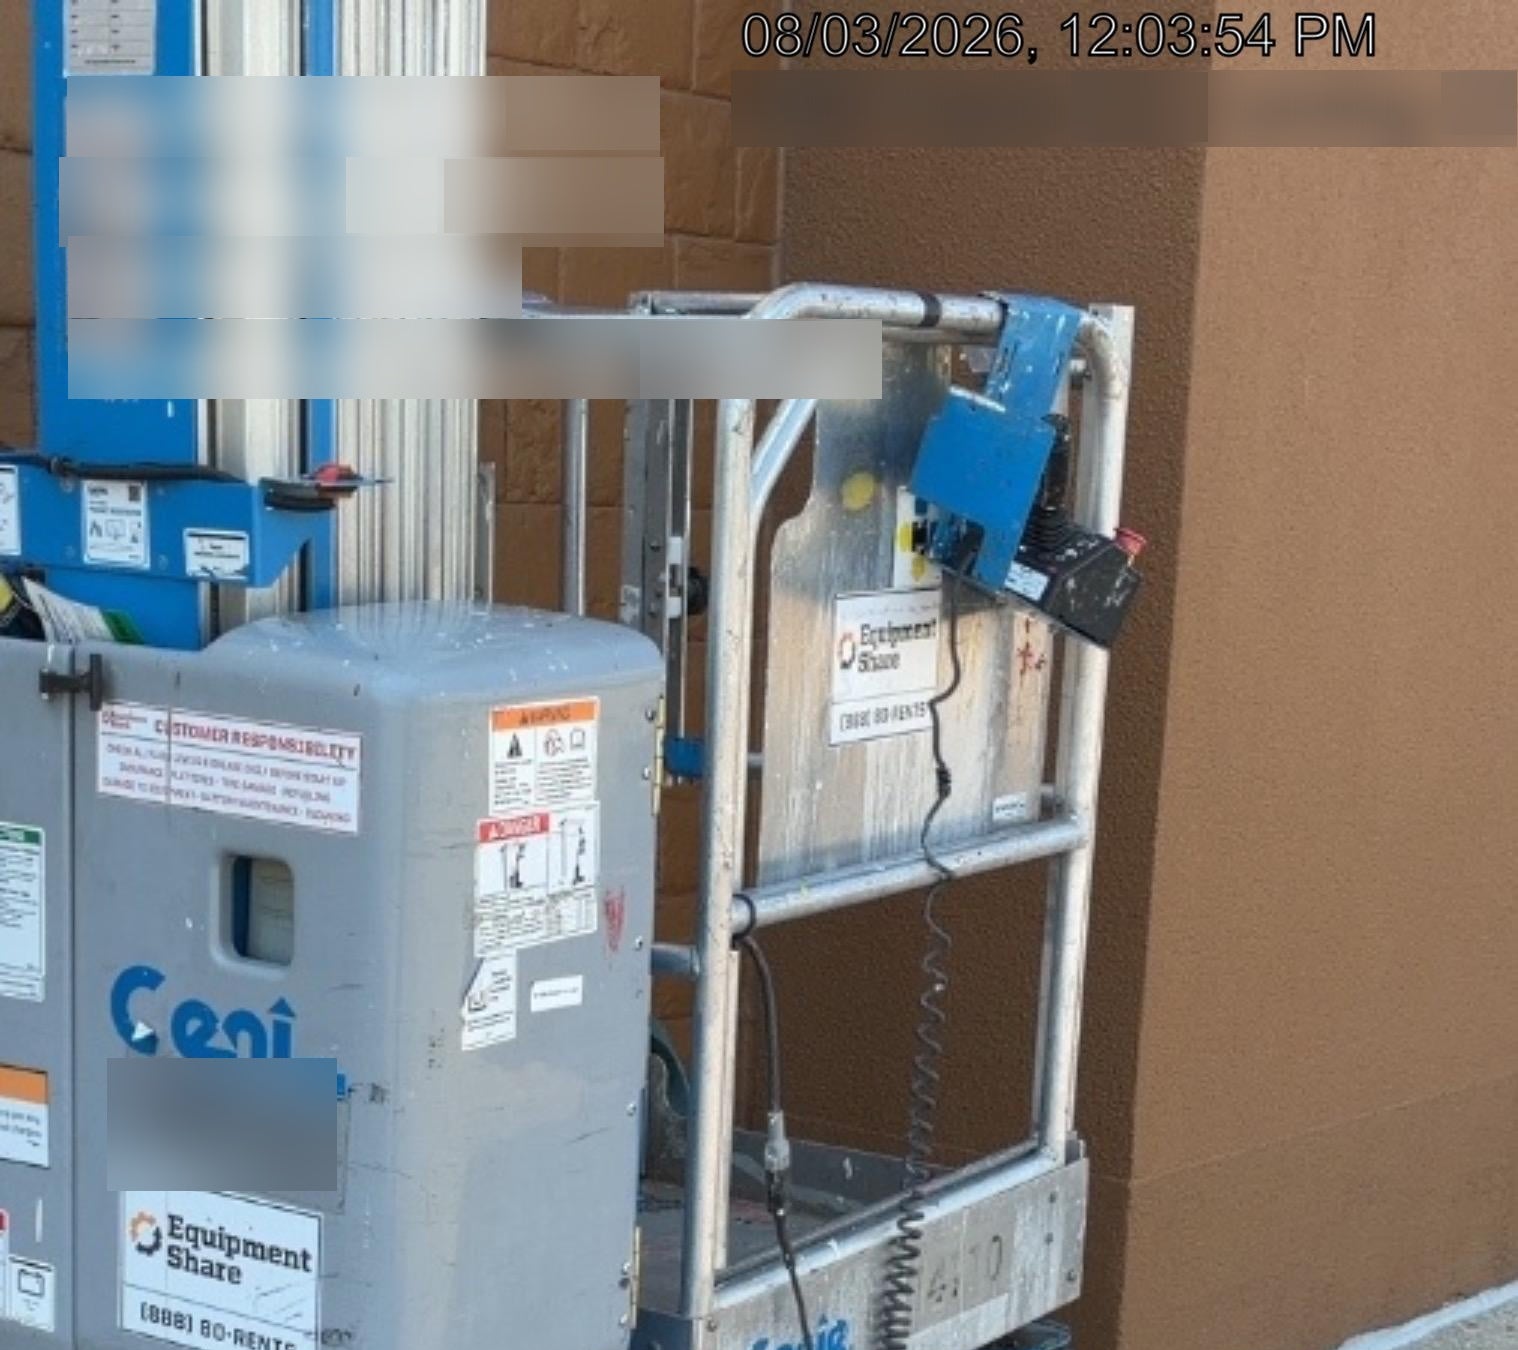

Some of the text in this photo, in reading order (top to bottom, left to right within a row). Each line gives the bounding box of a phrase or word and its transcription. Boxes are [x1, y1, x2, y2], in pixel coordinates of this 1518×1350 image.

[155, 718, 230, 745] CUSTOMER
[167, 1213, 312, 1273] Equipment
[166, 1244, 242, 1285] Share
